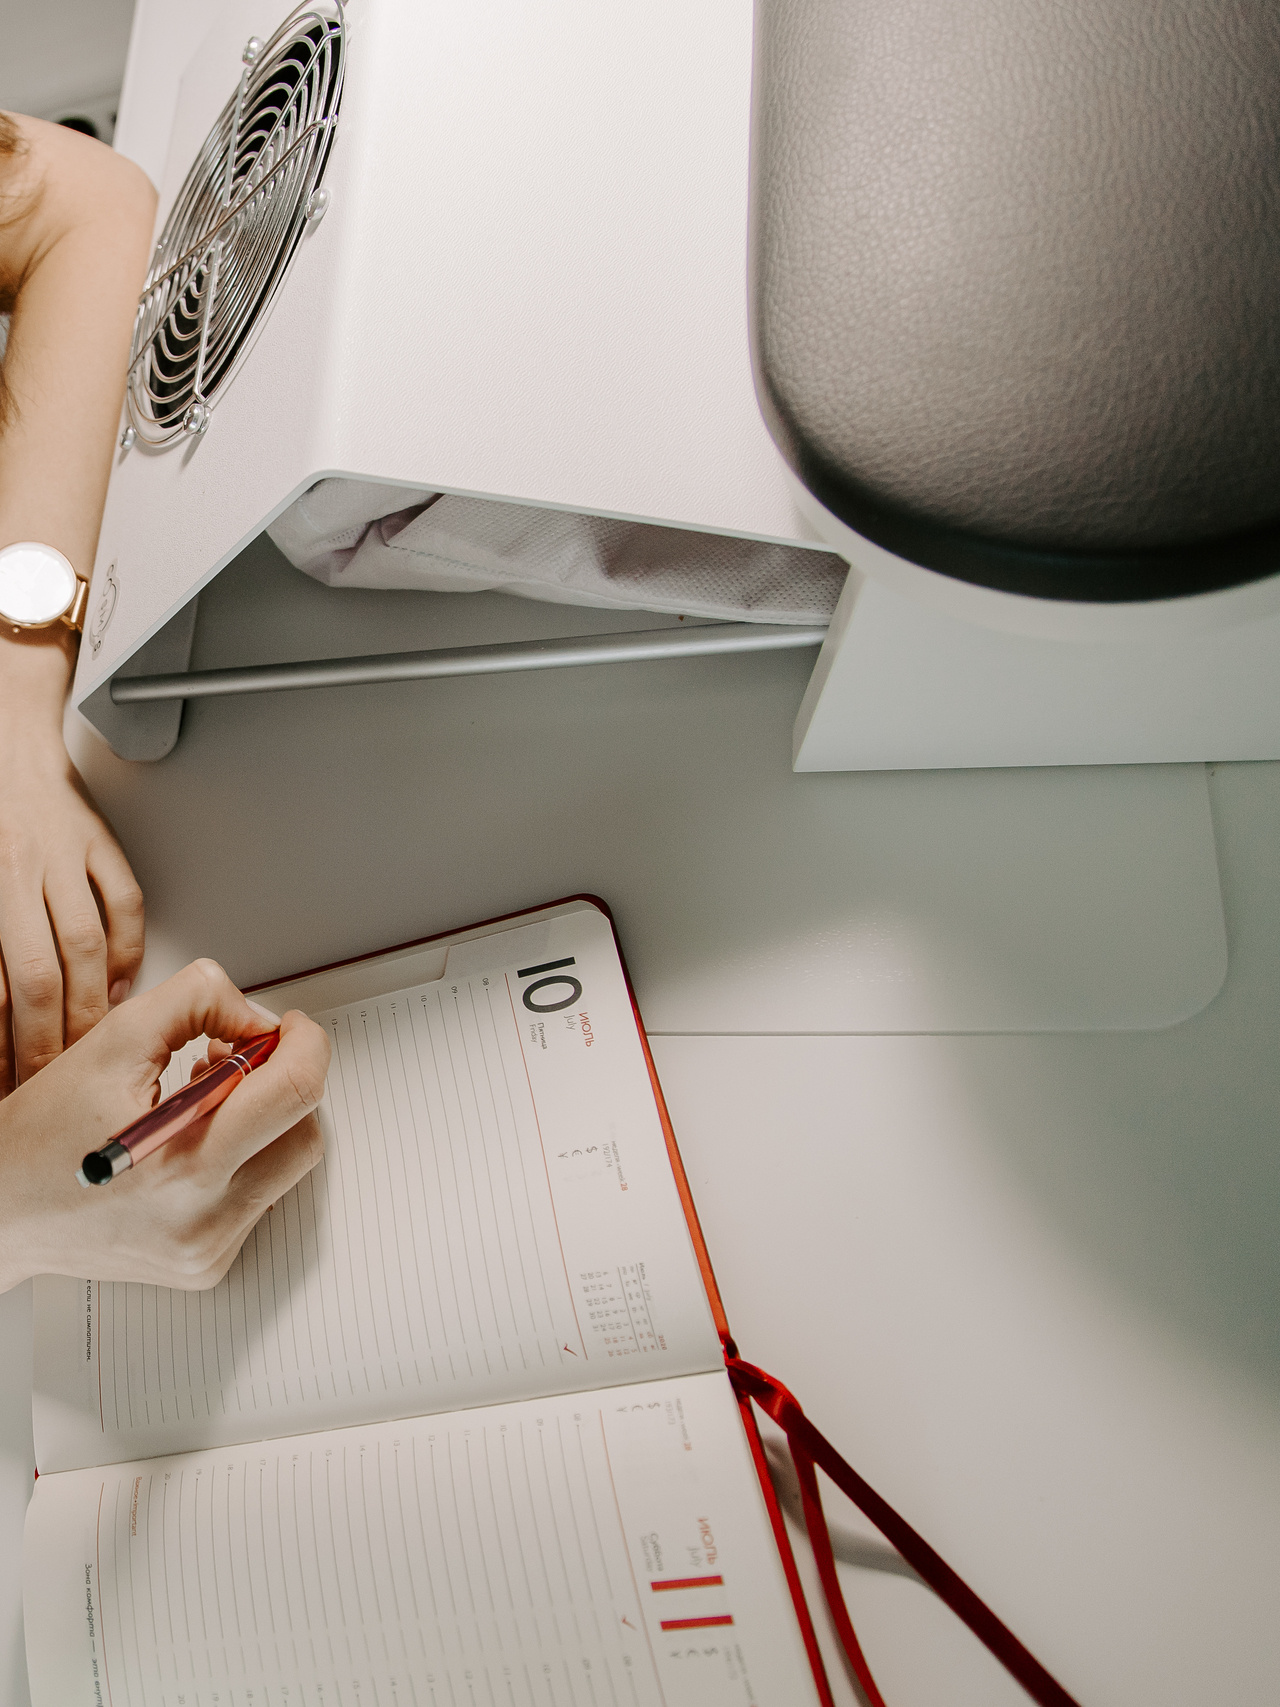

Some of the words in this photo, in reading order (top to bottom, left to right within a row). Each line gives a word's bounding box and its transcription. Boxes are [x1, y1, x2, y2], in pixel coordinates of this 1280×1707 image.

[451, 985, 457, 994] 09
[482, 977, 489, 986] 08
[517, 956, 583, 1014] 10
[420, 994, 427, 1002] 10
[331, 1018, 338, 1026] 13
[564, 1014, 577, 1030] July
[579, 1011, 594, 1047] ИЮЛЬ
[529, 1024, 538, 1043] Friday
[537, 1022, 547, 1049] Пятница
[620, 1183, 628, 1191] 28
[87, 1304, 91, 1313] не
[697, 1517, 717, 1565] ИЮЛЬ
[651, 1575, 734, 1632] 11
[86, 1588, 95, 1637] комфорта
